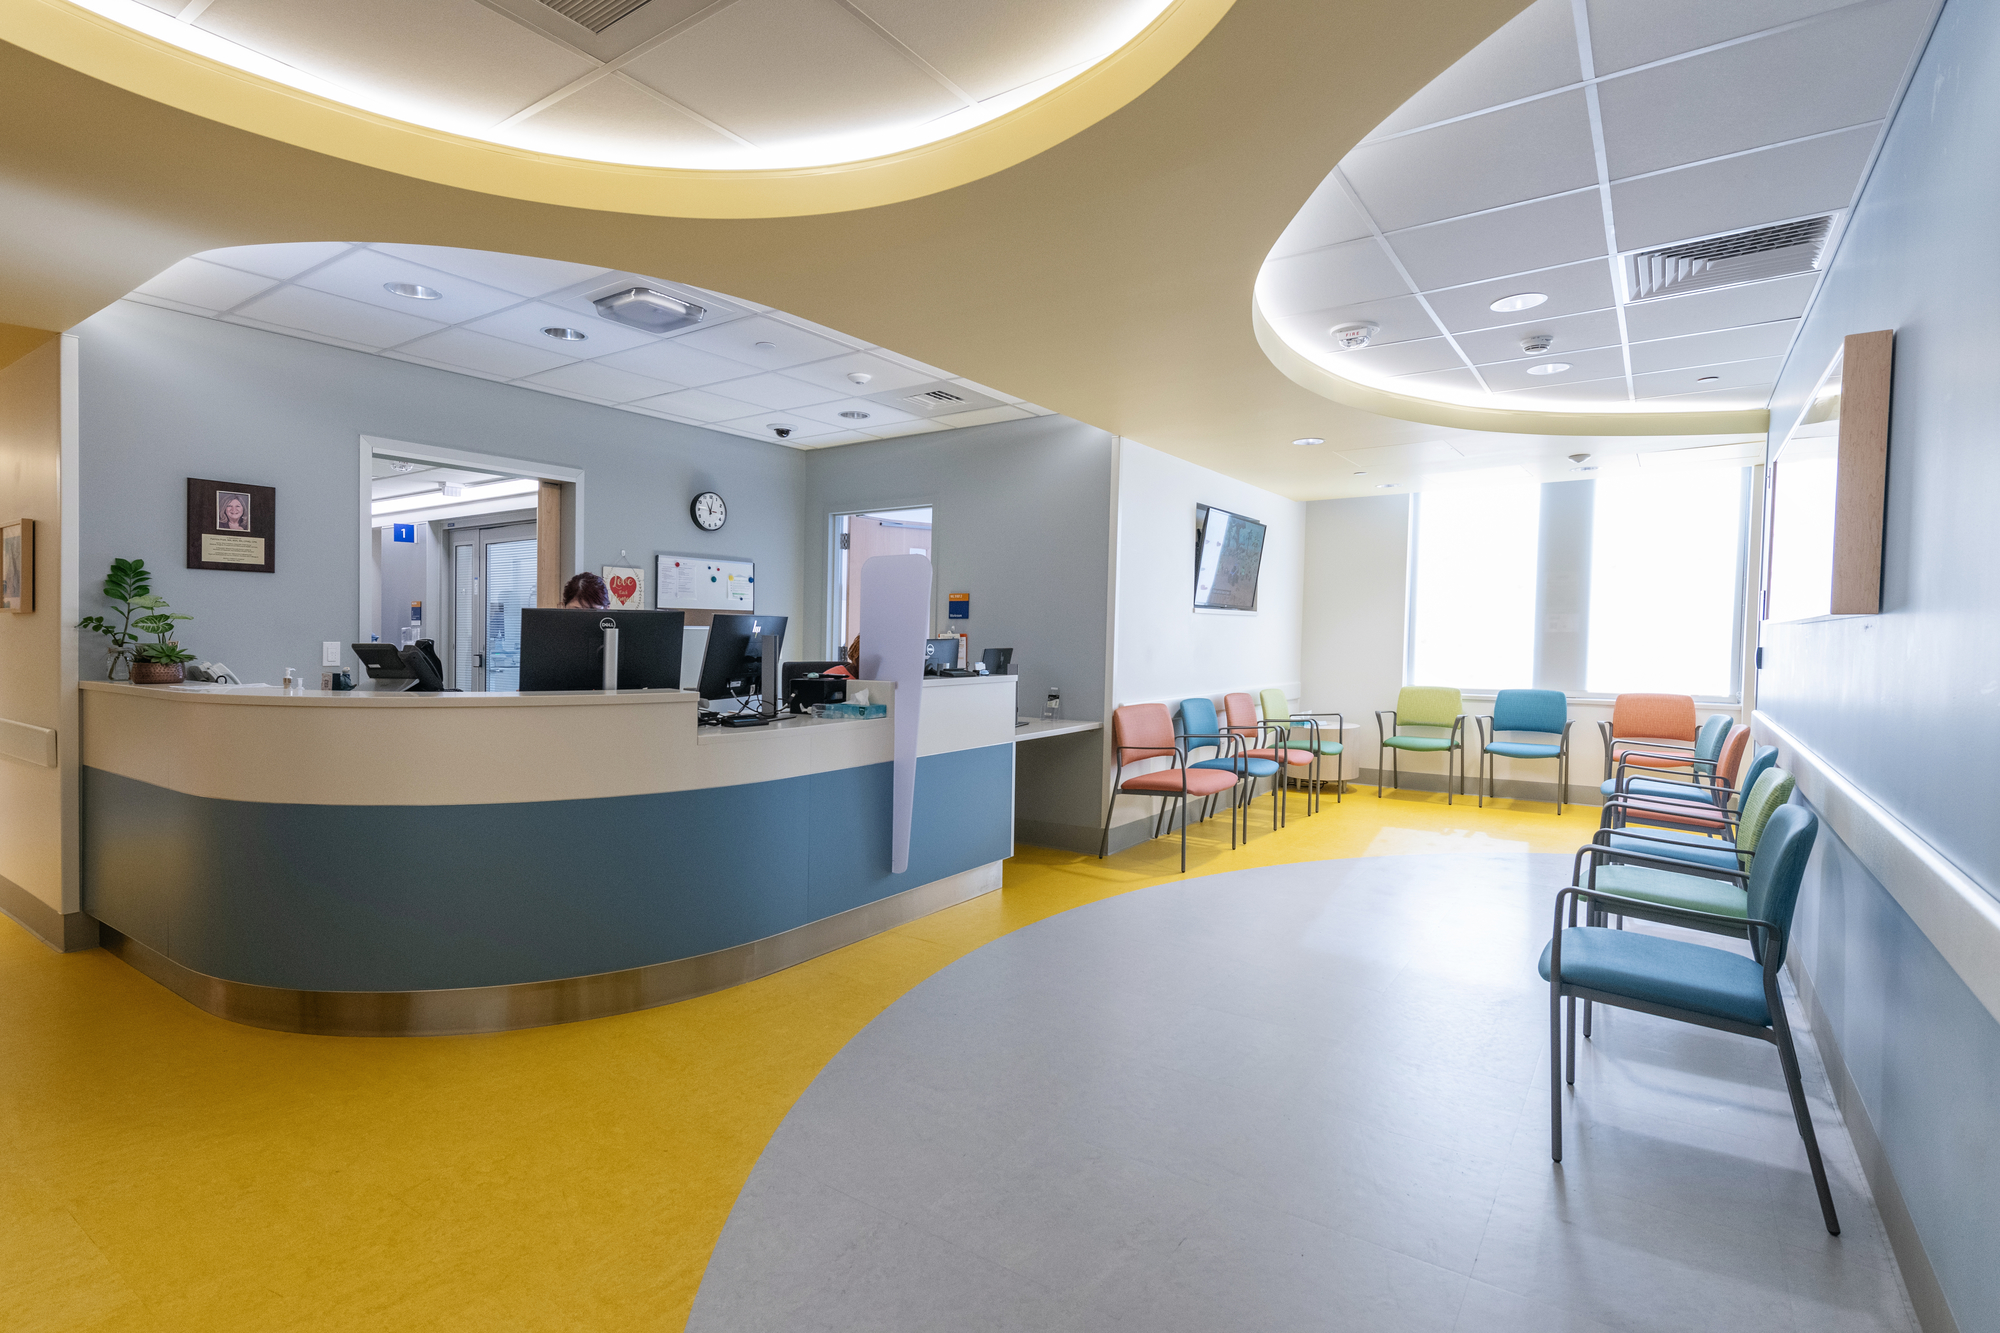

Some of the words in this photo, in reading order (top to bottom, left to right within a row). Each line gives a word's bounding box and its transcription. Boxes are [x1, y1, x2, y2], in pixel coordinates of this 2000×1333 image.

[401, 528, 405, 538] 1
[612, 573, 634, 589] Love
[611, 593, 635, 604] Moment
[752, 620, 761, 638] hp
